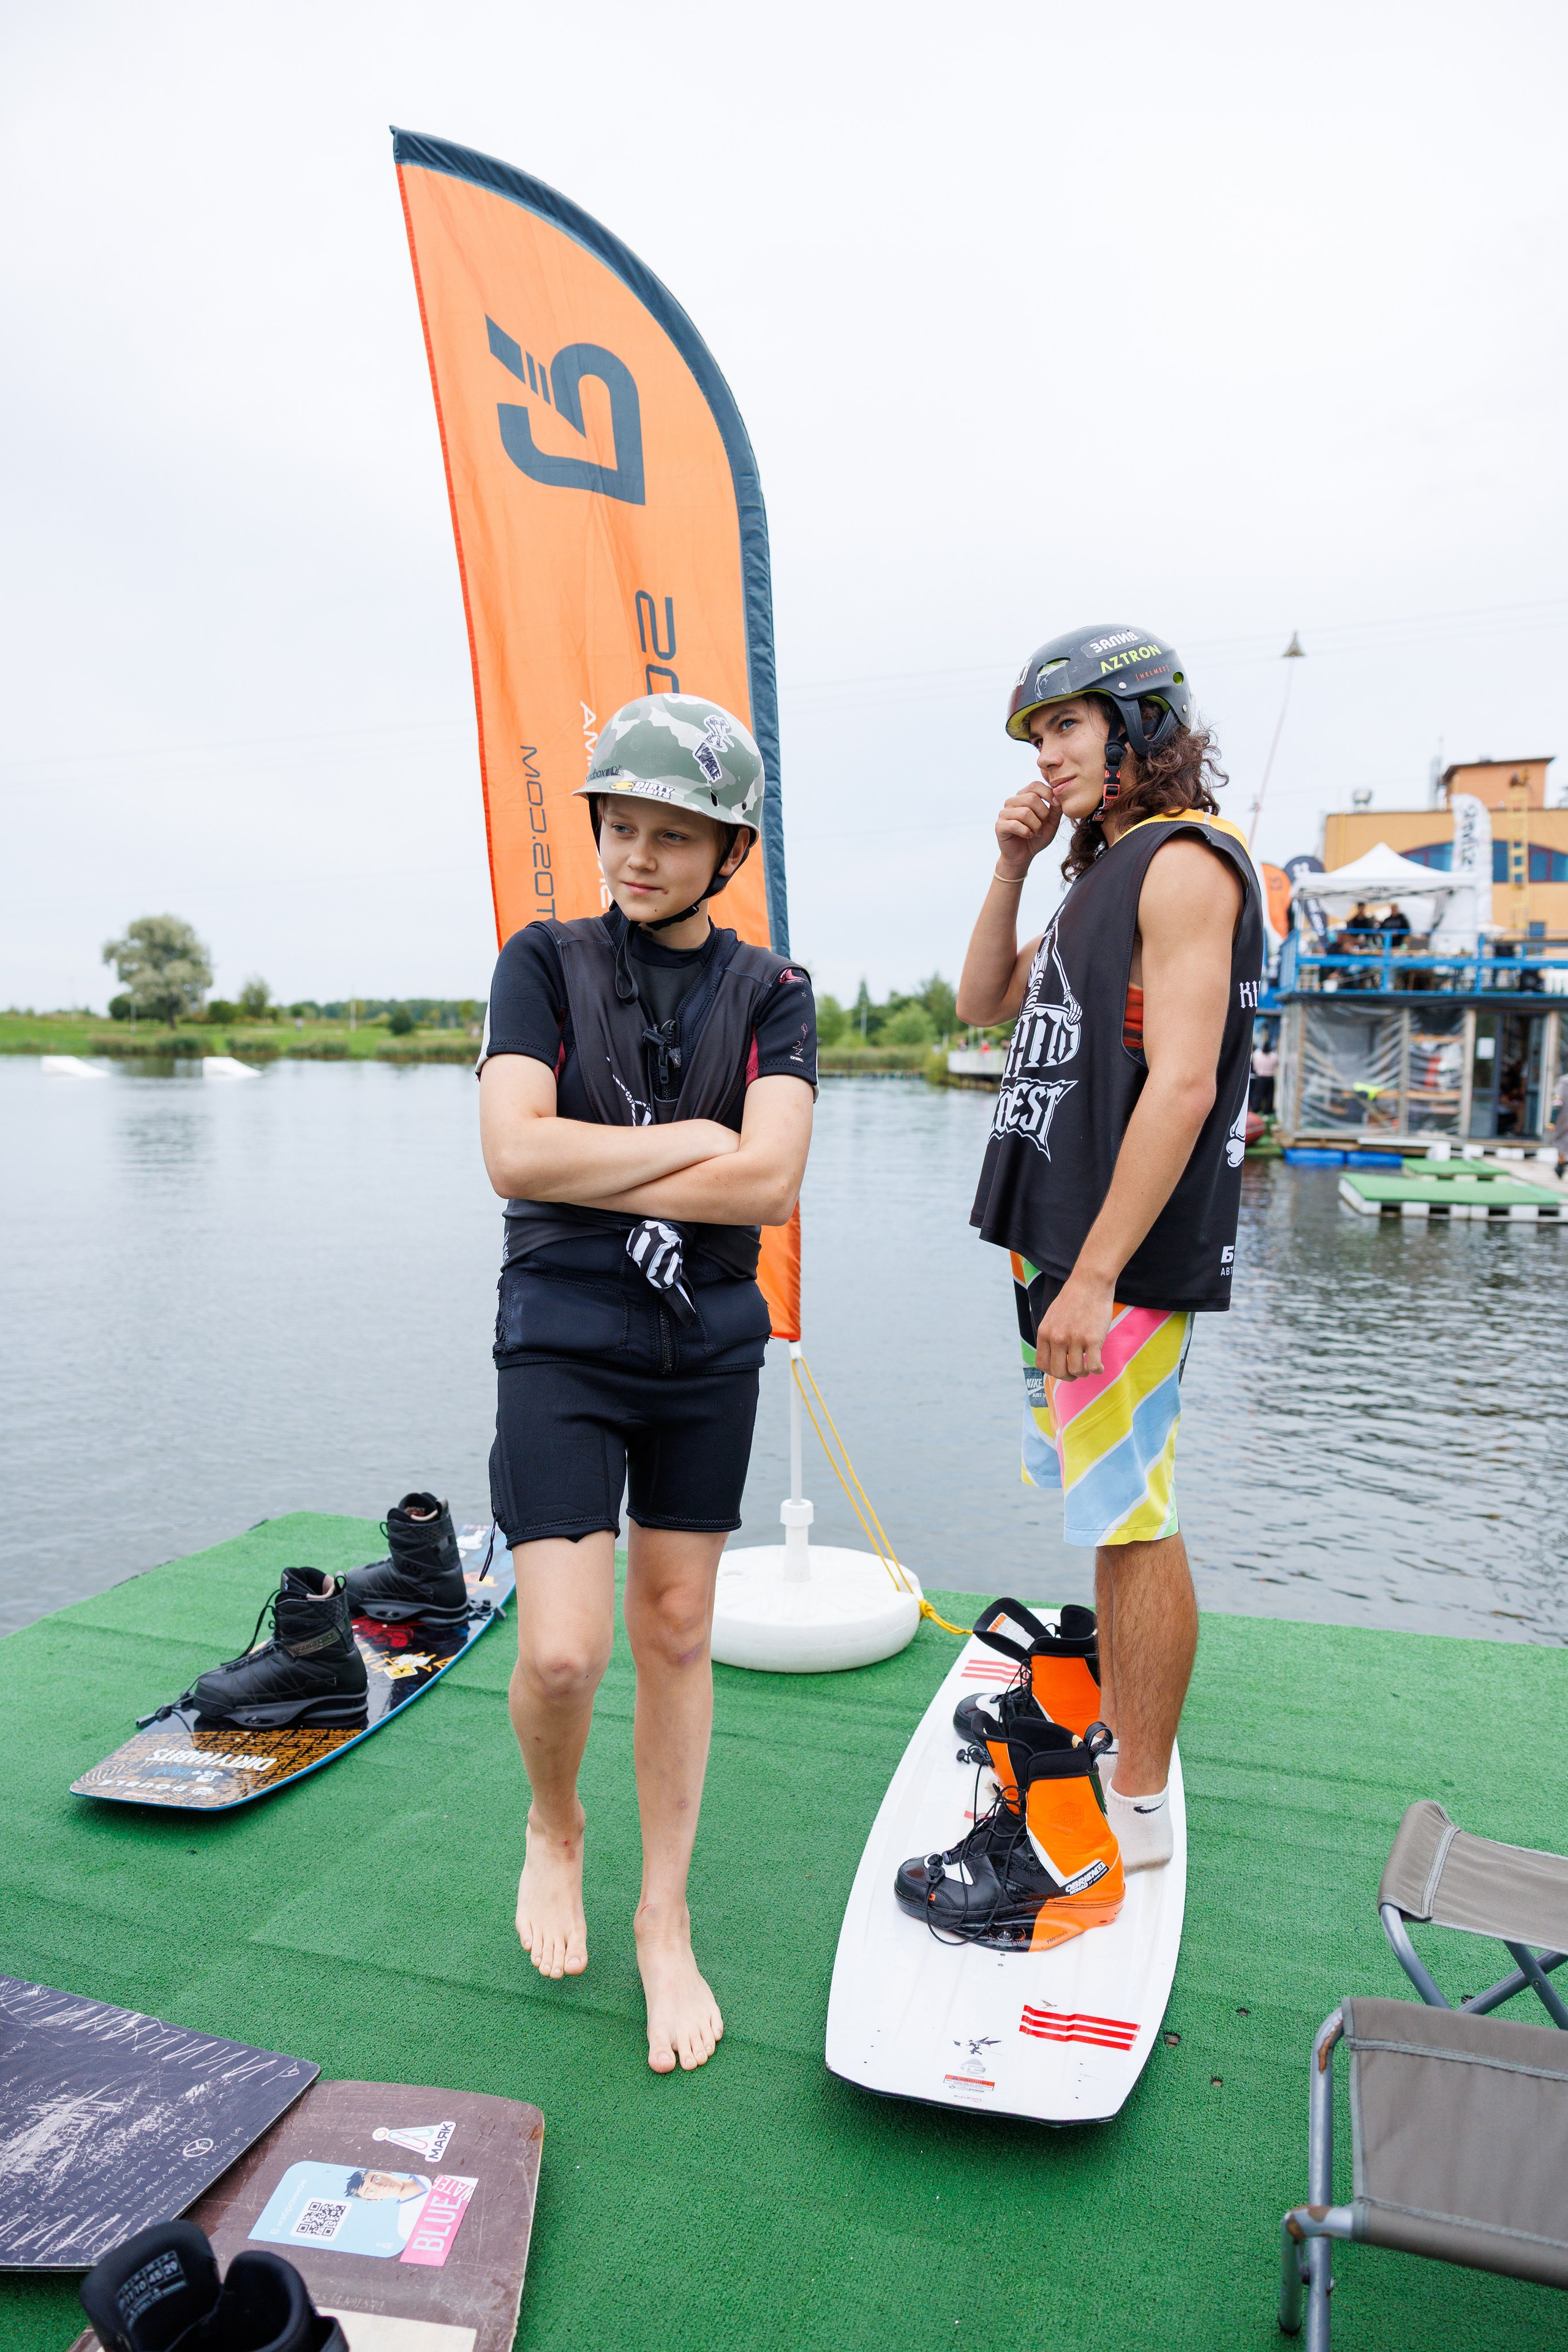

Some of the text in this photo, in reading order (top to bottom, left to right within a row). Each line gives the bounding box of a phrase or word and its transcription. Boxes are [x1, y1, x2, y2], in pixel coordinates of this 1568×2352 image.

[1100, 644, 1162, 674] AZTRON
[632, 787, 671, 799] HABITS
[634, 781, 675, 792] DIRTY
[1026, 1378, 1042, 1389] NIKE
[1069, 1883, 1088, 1895] NOMAD
[430, 2122, 454, 2160] МАЯК
[275, 2178, 309, 2225] избранное
[412, 2193, 464, 2255] BLUE
